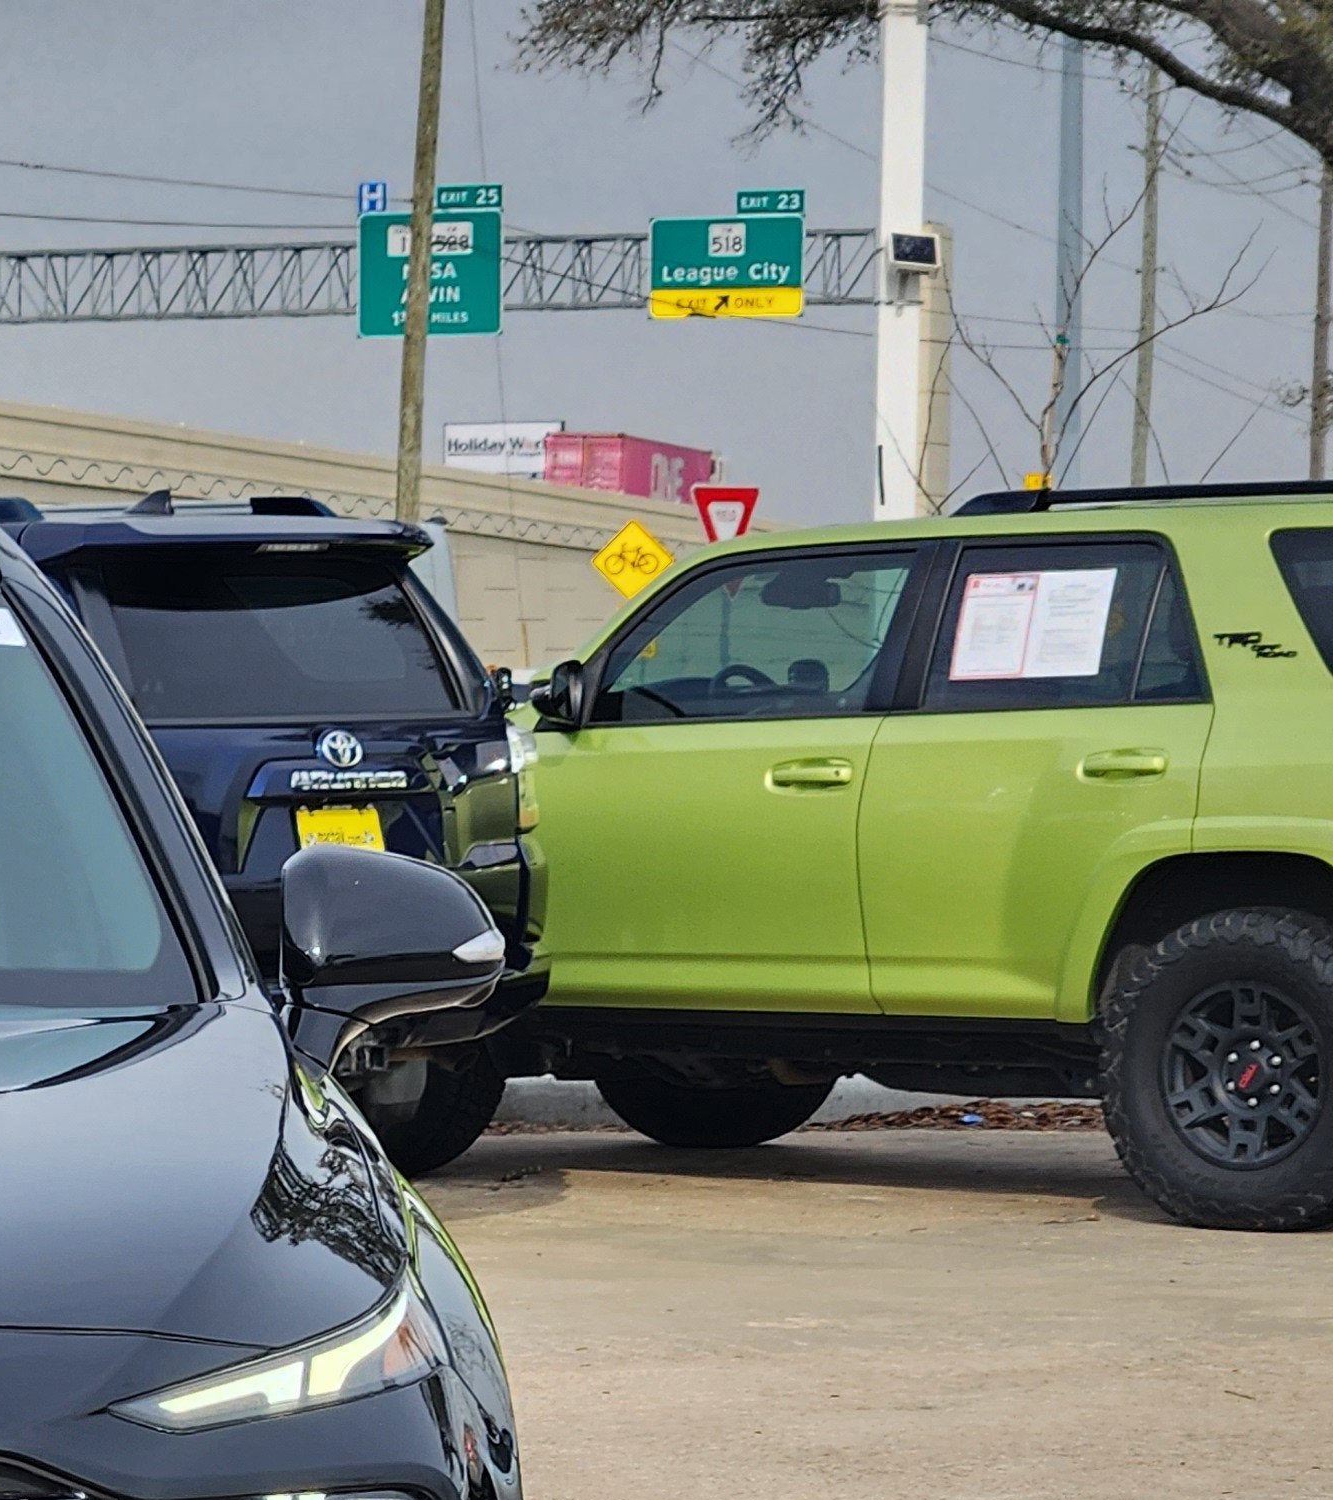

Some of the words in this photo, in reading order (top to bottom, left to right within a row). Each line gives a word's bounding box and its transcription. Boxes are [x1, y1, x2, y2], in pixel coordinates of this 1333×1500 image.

[439, 190, 469, 204] EXIT
[475, 187, 500, 206] 25
[739, 196, 769, 209] EXIT
[776, 193, 801, 210] 23
[711, 235, 743, 253] 518
[401, 261, 458, 281] SA
[661, 264, 739, 287] League
[747, 261, 791, 285] City
[400, 285, 461, 305] VIN
[734, 296, 775, 309] ONLY
[447, 437, 506, 453] Holiday
